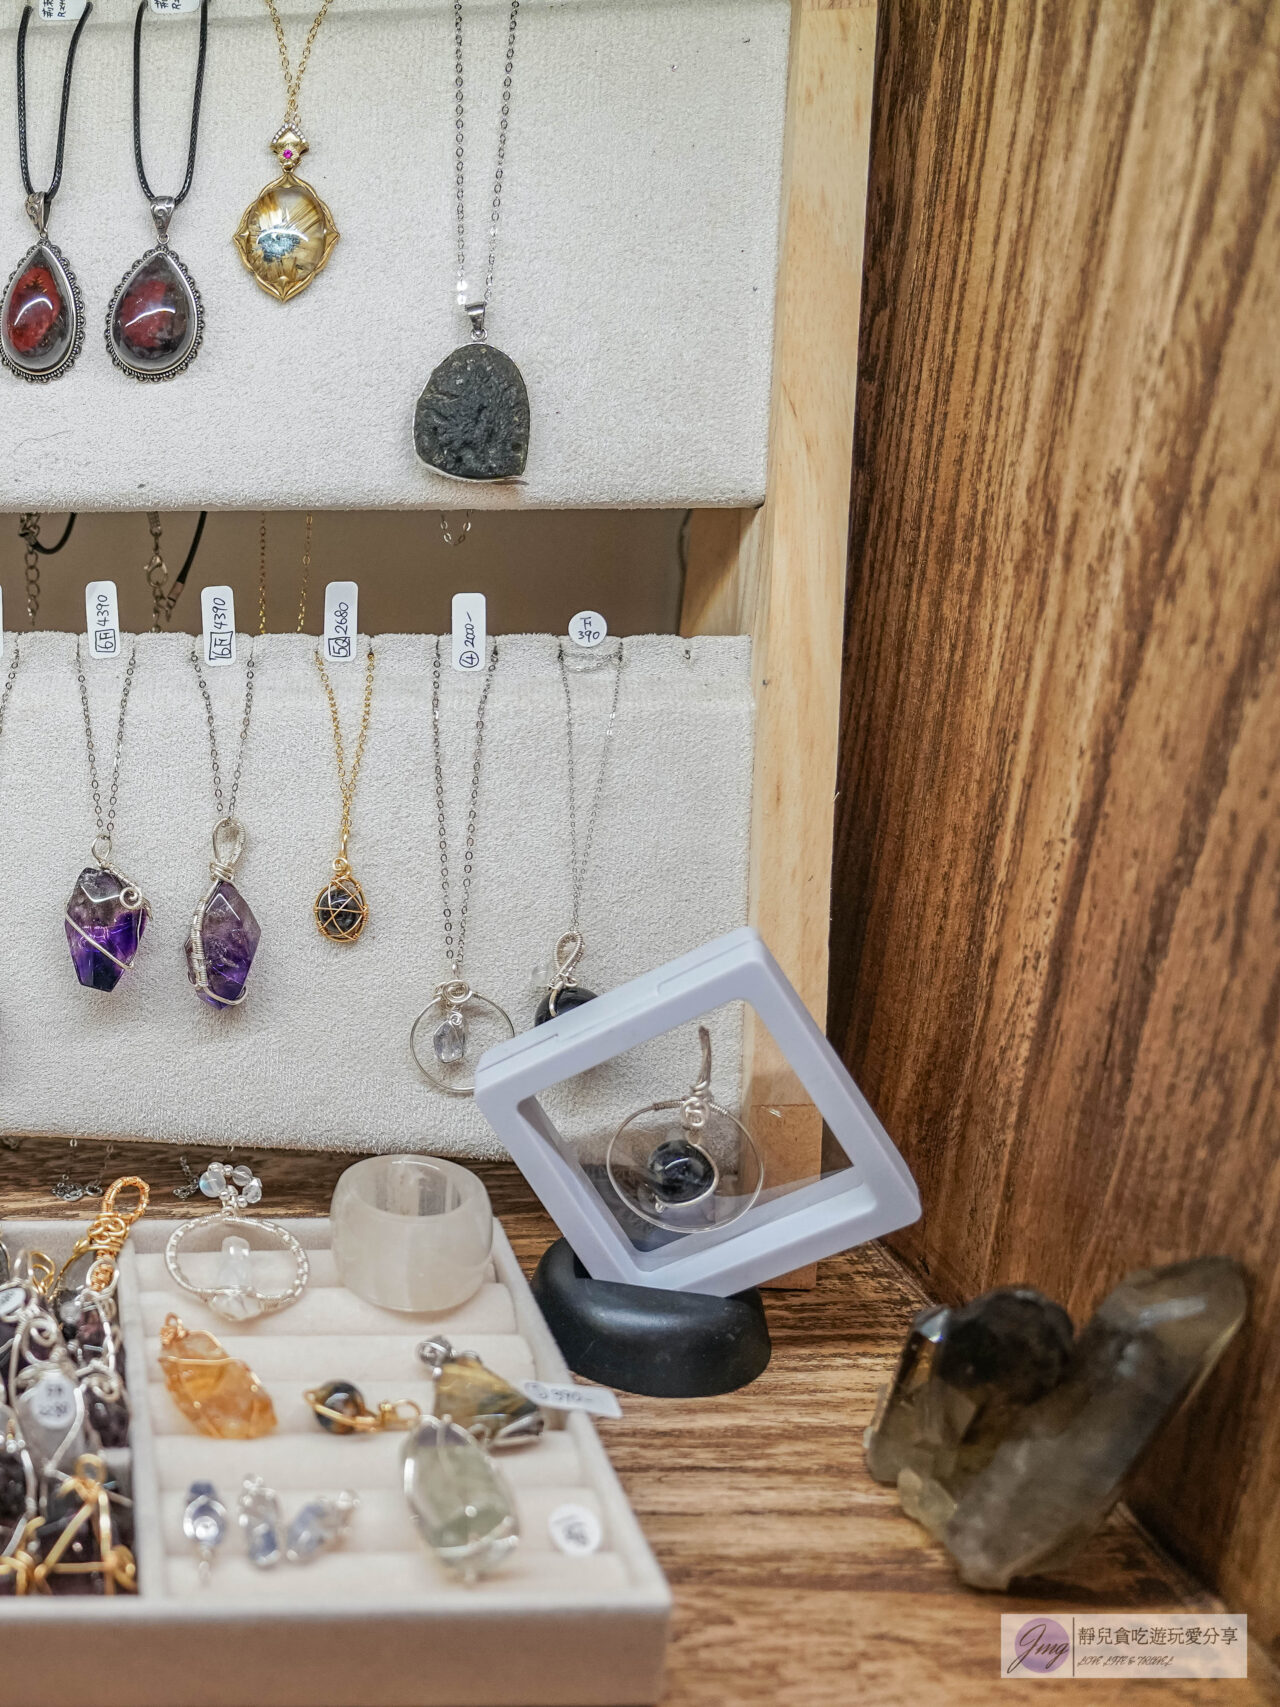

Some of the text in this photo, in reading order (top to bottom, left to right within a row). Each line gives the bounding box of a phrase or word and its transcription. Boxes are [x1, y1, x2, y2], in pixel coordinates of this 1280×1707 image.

[97, 595, 110, 627] 4390
[213, 597, 227, 630] 4390
[334, 602, 349, 635] 2680
[578, 630, 600, 643] 390
